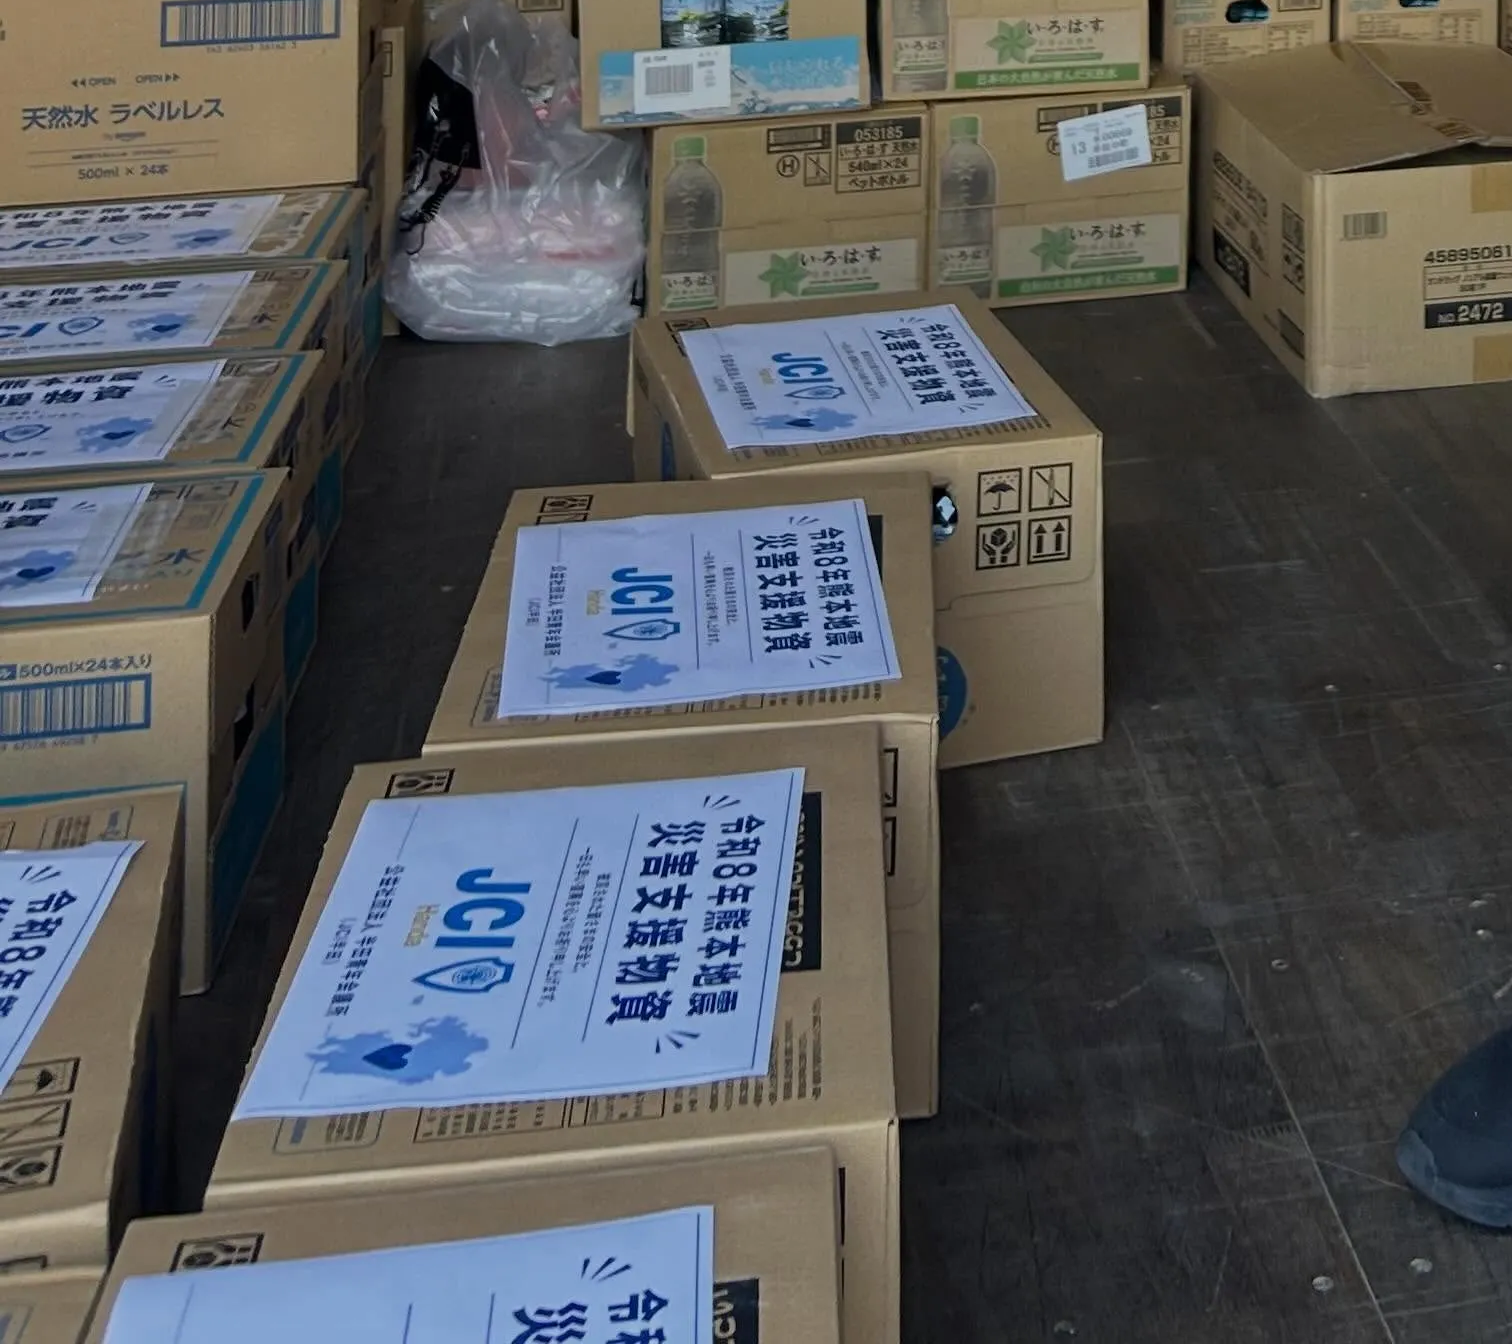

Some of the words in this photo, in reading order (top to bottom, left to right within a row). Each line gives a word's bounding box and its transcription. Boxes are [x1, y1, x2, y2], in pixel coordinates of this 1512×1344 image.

[88, 76, 117, 87] OPEN
[135, 73, 164, 85] OPEN
[22, 104, 99, 132] 天然水
[110, 97, 225, 124] ラベルレス
[78, 166, 119, 181] 500ml
[1458, 302, 1505, 322] 2472
[770, 351, 834, 384] JCI
[610, 566, 675, 616] JCI
[752, 532, 812, 654] 災害支援物資
[807, 526, 865, 647] 令和8年熊本地震
[434, 867, 533, 949] JCI
[605, 820, 707, 1026] 災害支援物資
[687, 813, 766, 1017] 令和8年熊本地震
